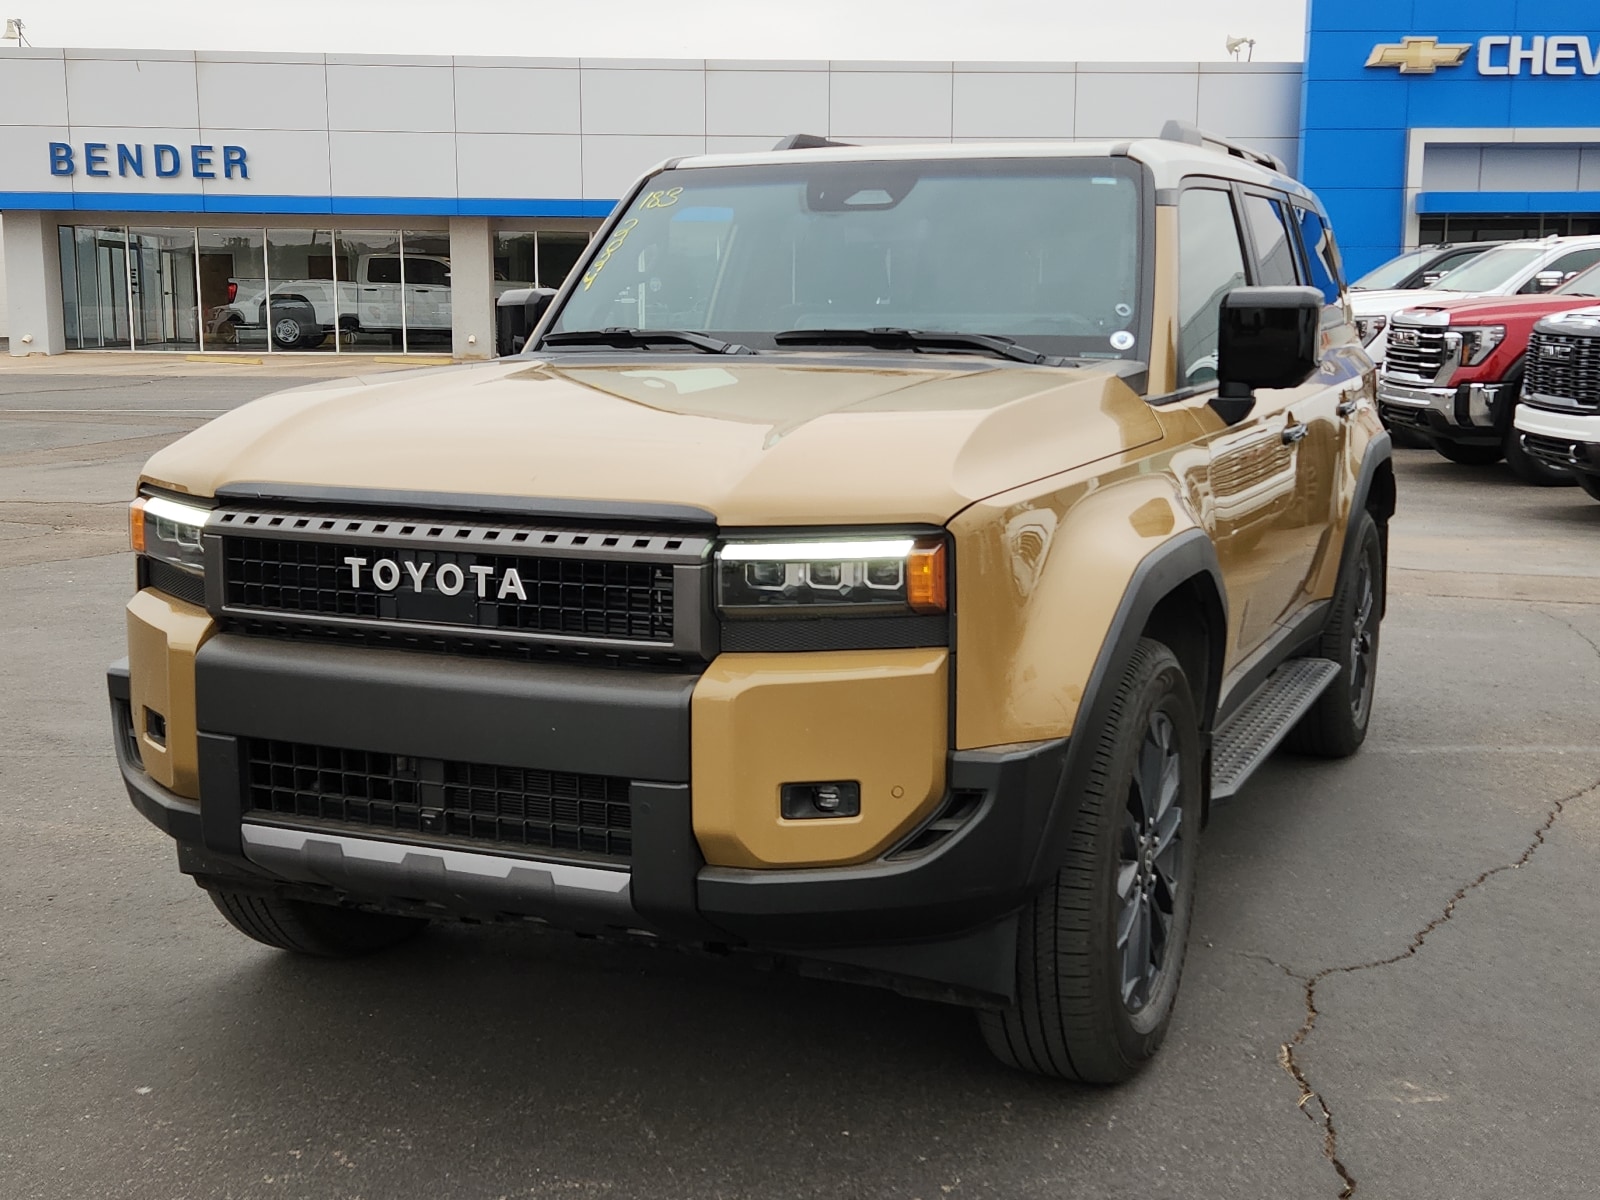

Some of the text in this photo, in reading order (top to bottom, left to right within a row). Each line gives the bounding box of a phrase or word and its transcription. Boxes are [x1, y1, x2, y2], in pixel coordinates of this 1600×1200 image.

[48, 141, 250, 180] BENDER
[638, 186, 685, 212] 183
[344, 556, 527, 601] TOYOTA
